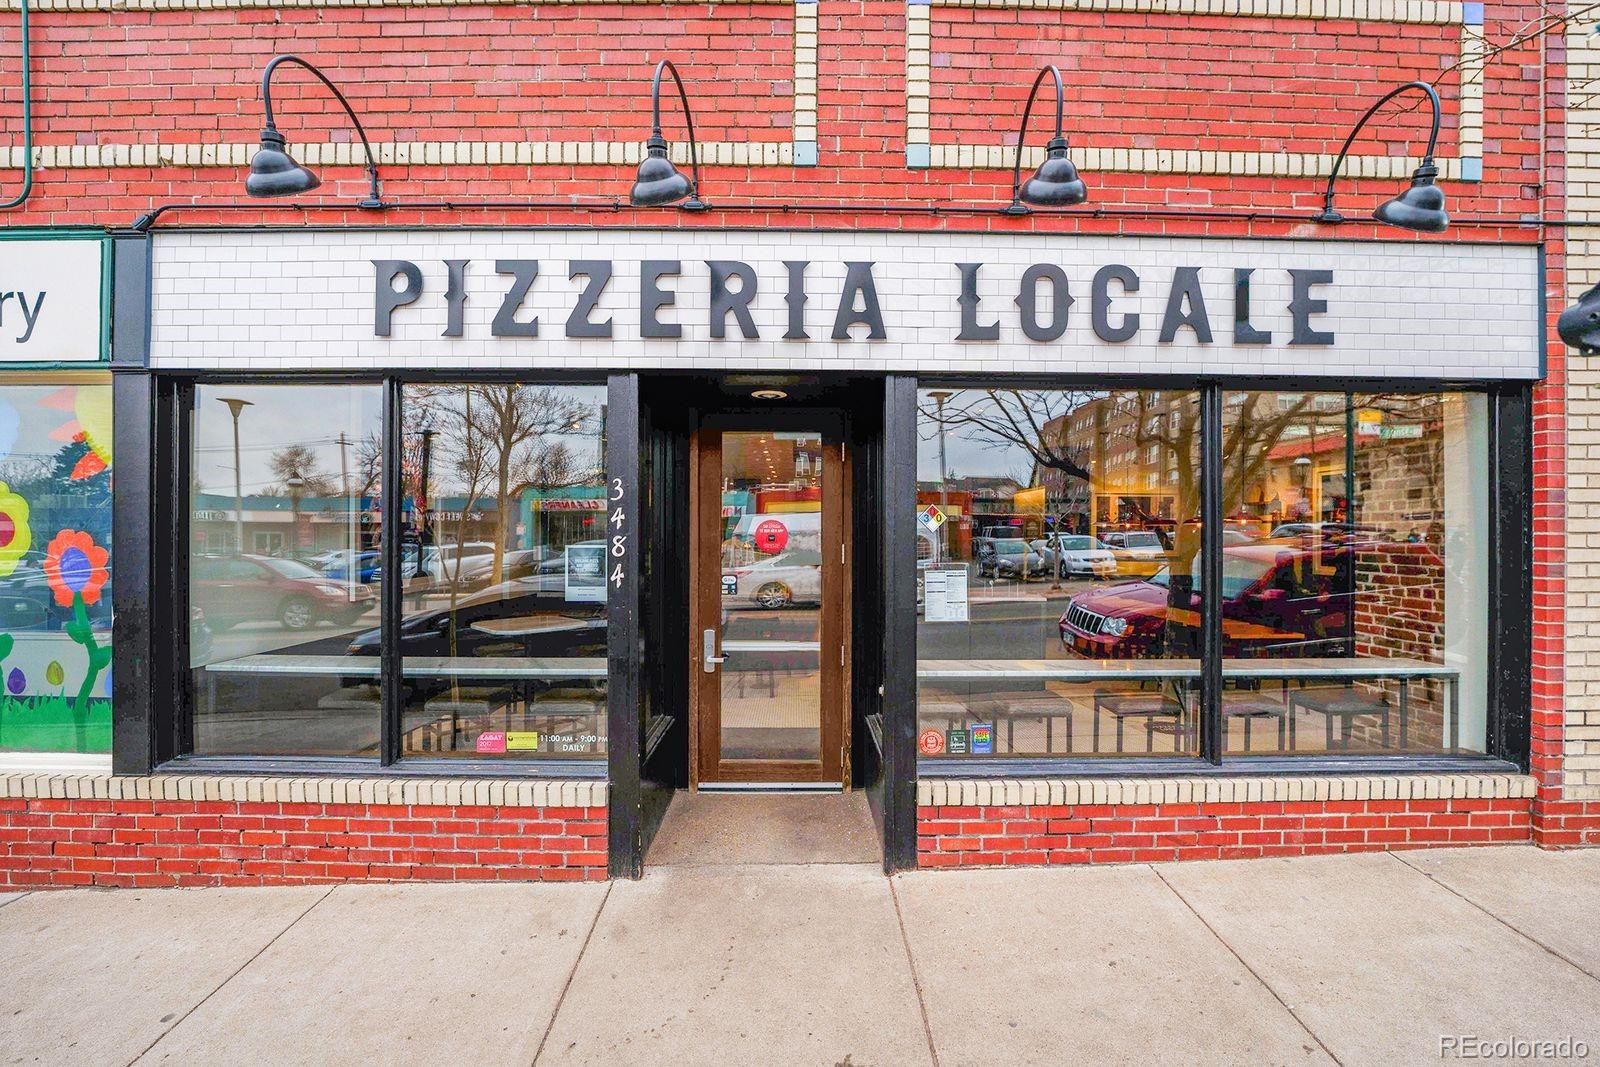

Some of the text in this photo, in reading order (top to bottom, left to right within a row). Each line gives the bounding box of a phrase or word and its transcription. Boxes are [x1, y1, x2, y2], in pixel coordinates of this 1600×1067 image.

[370, 259, 1335, 348] PIZZERIA LOCALE
[610, 477, 627, 590] 3484
[540, 734, 560, 743] 11:00
[580, 735, 597, 743] 9:00
[562, 744, 585, 752] DAILY
